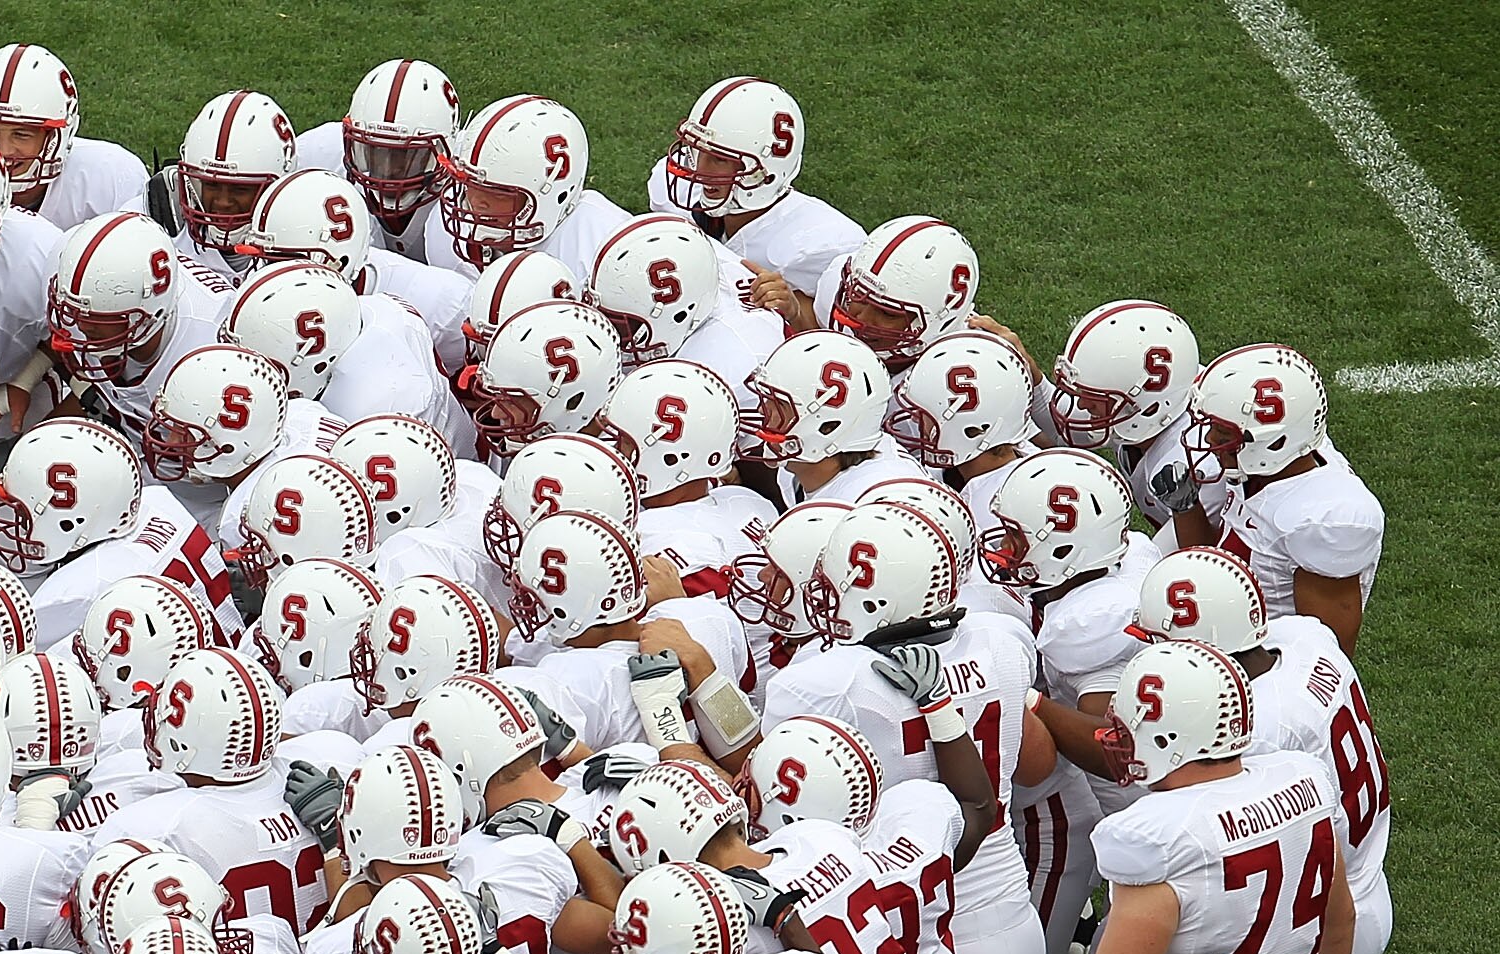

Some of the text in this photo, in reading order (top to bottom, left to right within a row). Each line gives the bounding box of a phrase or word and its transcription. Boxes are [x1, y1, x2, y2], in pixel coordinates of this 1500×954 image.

[543, 134, 571, 180] S
[772, 111, 795, 157] S
[208, 161, 230, 170] CARDINAL
[324, 195, 354, 242] S
[150, 248, 172, 295] S
[647, 259, 681, 304] S
[296, 310, 326, 355] S
[544, 336, 580, 383] S
[1144, 346, 1173, 391] S
[217, 383, 252, 431] S
[815, 360, 852, 409] S
[947, 364, 980, 412] S
[1253, 377, 1285, 425] S
[652, 394, 688, 443] S
[47, 463, 78, 509] S
[364, 455, 398, 502] S
[272, 487, 304, 536] S
[1047, 485, 1080, 533] S
[134, 516, 178, 553] WILKES
[541, 548, 568, 595] S
[848, 540, 878, 590] S
[281, 593, 308, 641] S
[1166, 579, 1200, 628] S
[106, 608, 135, 657] S
[387, 606, 417, 655] S
[1136, 674, 1165, 723] S
[63, 743, 77, 756] 29
[515, 732, 542, 751] Riddell
[777, 757, 808, 806] S
[1217, 776, 1326, 843] McGILLICUDDY
[408, 849, 445, 862] Riddell
[433, 829, 449, 843] 80
